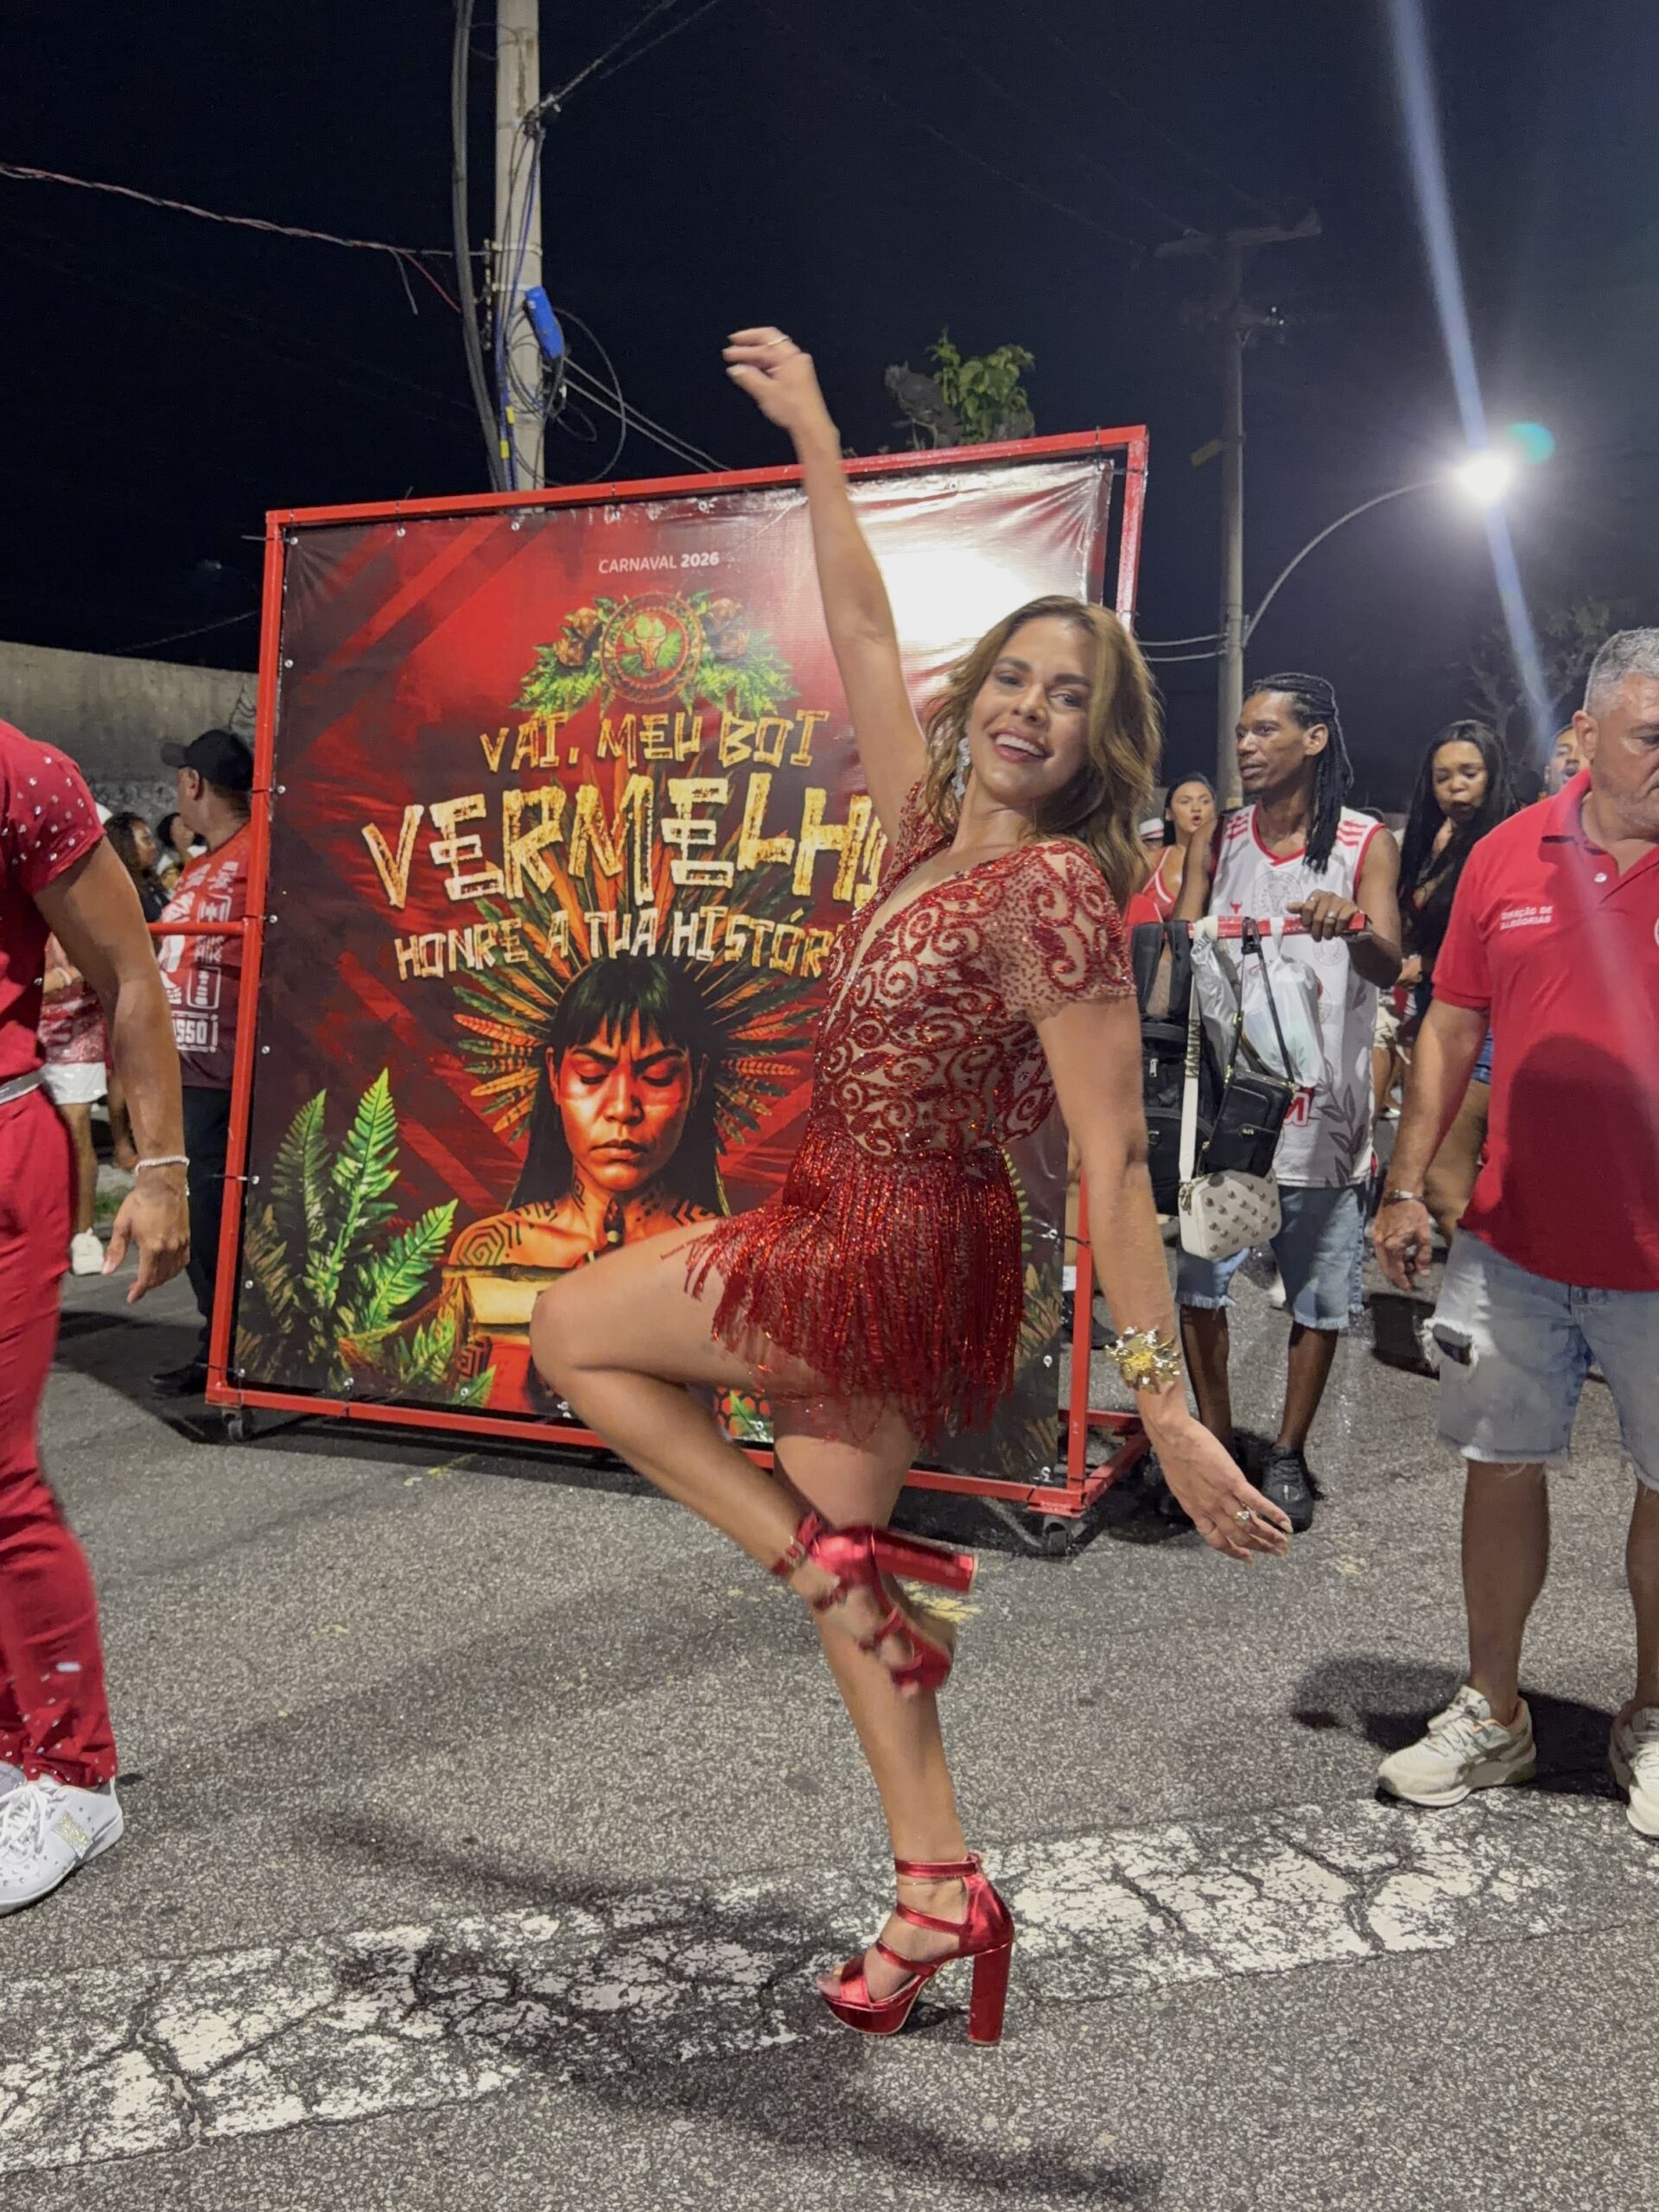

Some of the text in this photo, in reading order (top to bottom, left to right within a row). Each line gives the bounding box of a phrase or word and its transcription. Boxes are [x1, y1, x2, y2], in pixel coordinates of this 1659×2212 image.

[598, 551, 720, 574] CARNAVAL 2026
[597, 711, 704, 769] MEU
[718, 709, 830, 768] BOI
[393, 905, 843, 981] HONRE A TUA HISTÓR
